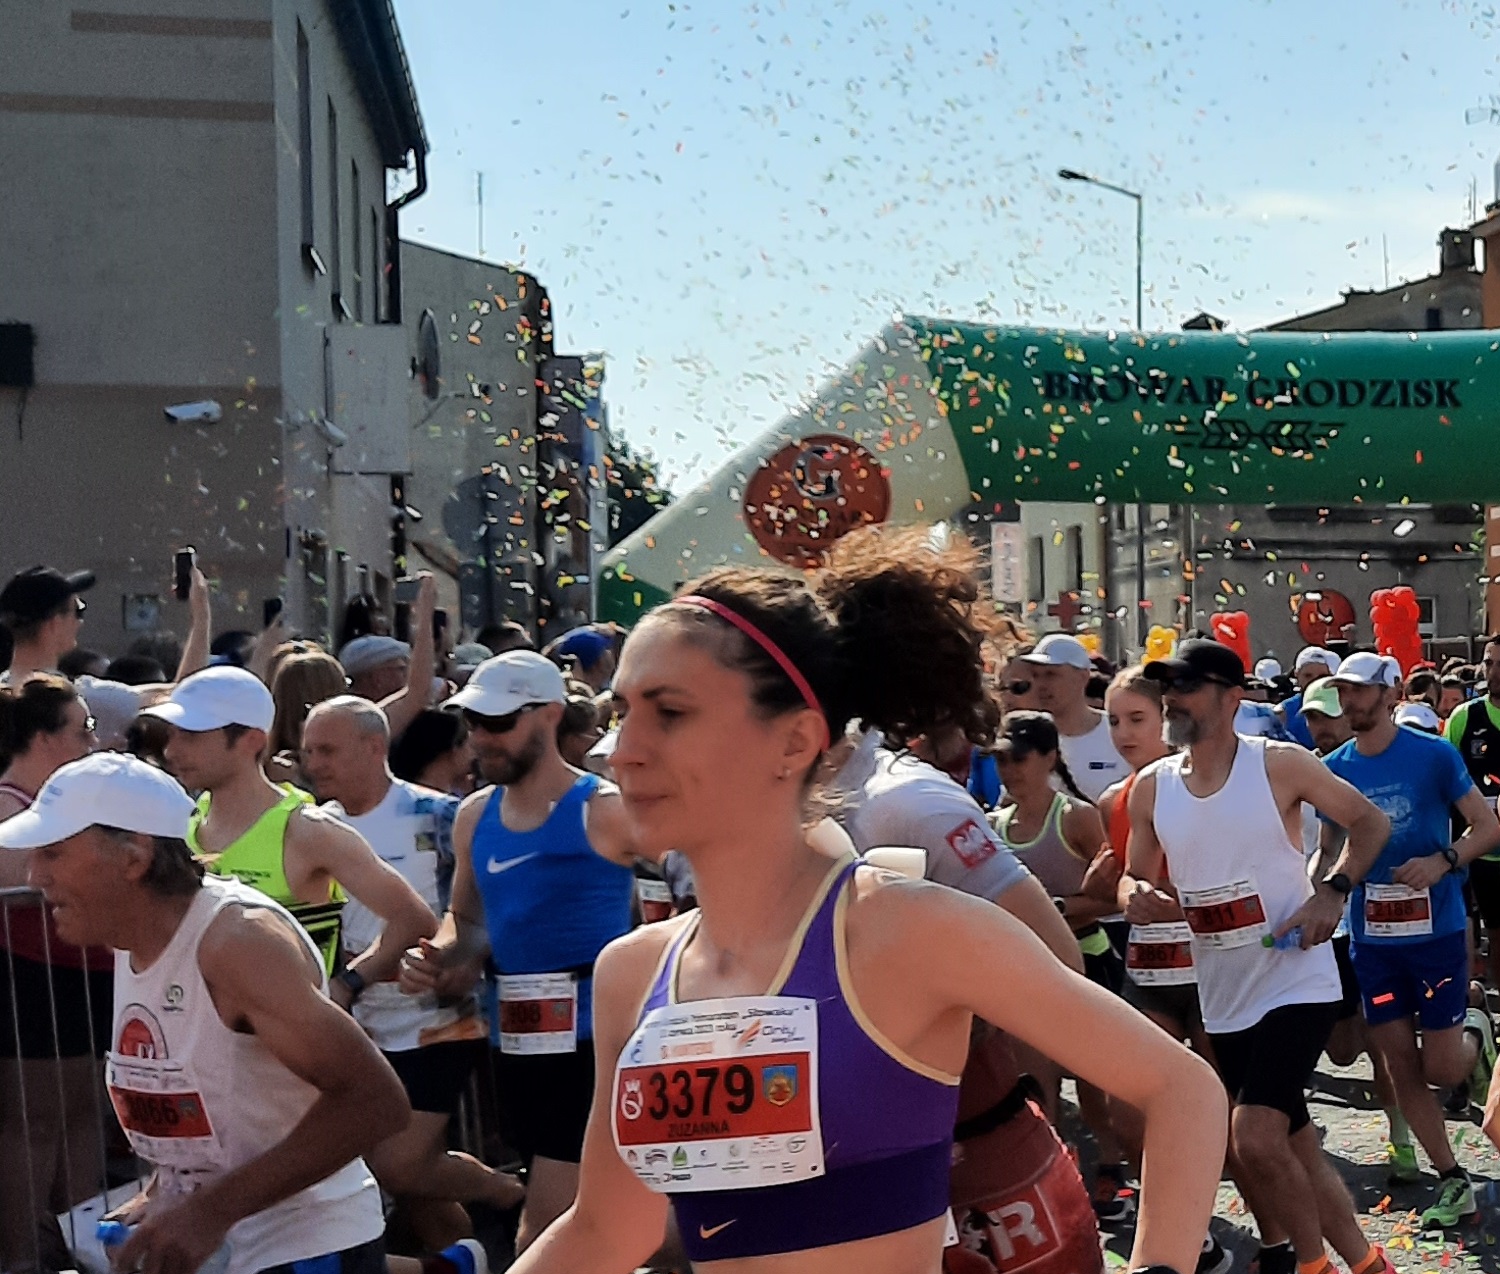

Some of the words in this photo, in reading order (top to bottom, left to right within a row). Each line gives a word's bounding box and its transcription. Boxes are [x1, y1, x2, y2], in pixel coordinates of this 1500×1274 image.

[1043, 371, 1226, 406] BROWAR
[1246, 377, 1462, 409] GRODZISK
[649, 1063, 756, 1122] 3379
[668, 1120, 731, 1139] ZUZANNA
